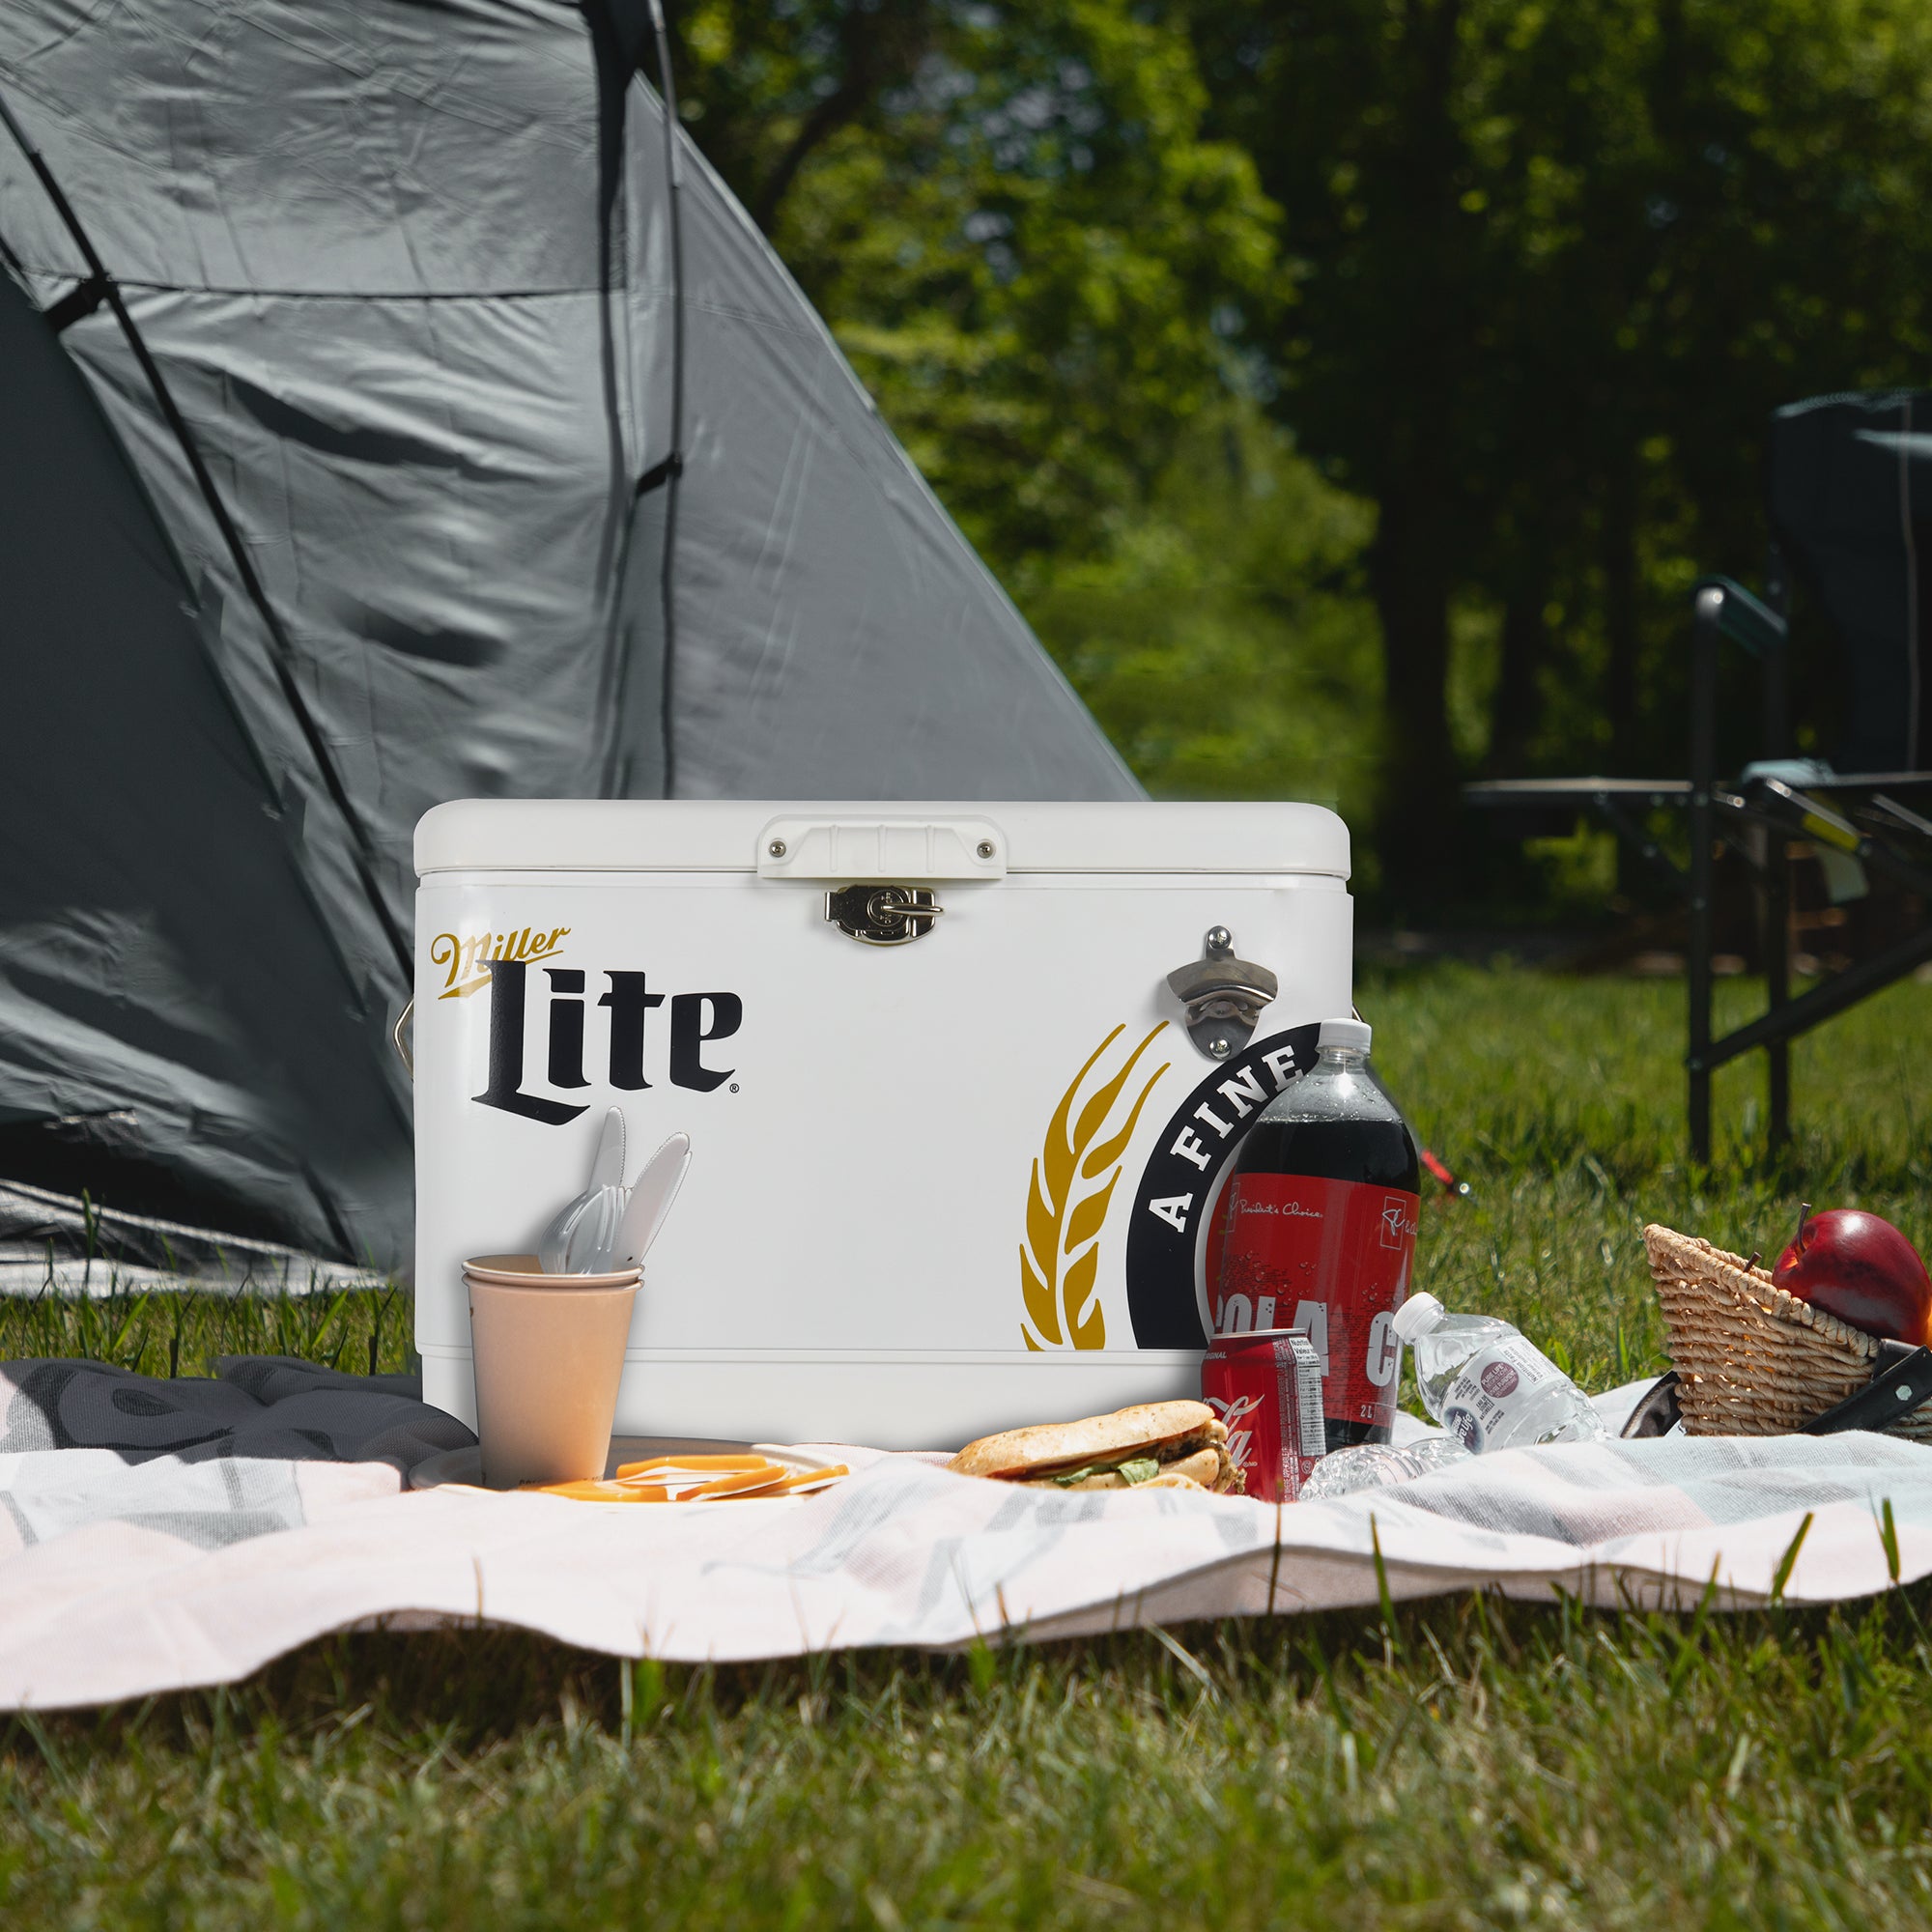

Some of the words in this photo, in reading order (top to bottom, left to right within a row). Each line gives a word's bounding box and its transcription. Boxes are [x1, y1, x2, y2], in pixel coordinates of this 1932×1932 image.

[431, 927, 571, 991] Miller
[1170, 1044, 1304, 1172] FINE
[1149, 1192, 1193, 1233] A
[1239, 1199, 1279, 1214] President's
[1282, 1201, 1323, 1218] Choice
[1481, 1372, 1494, 1385] PURE
[1492, 1363, 1504, 1375] LIFE
